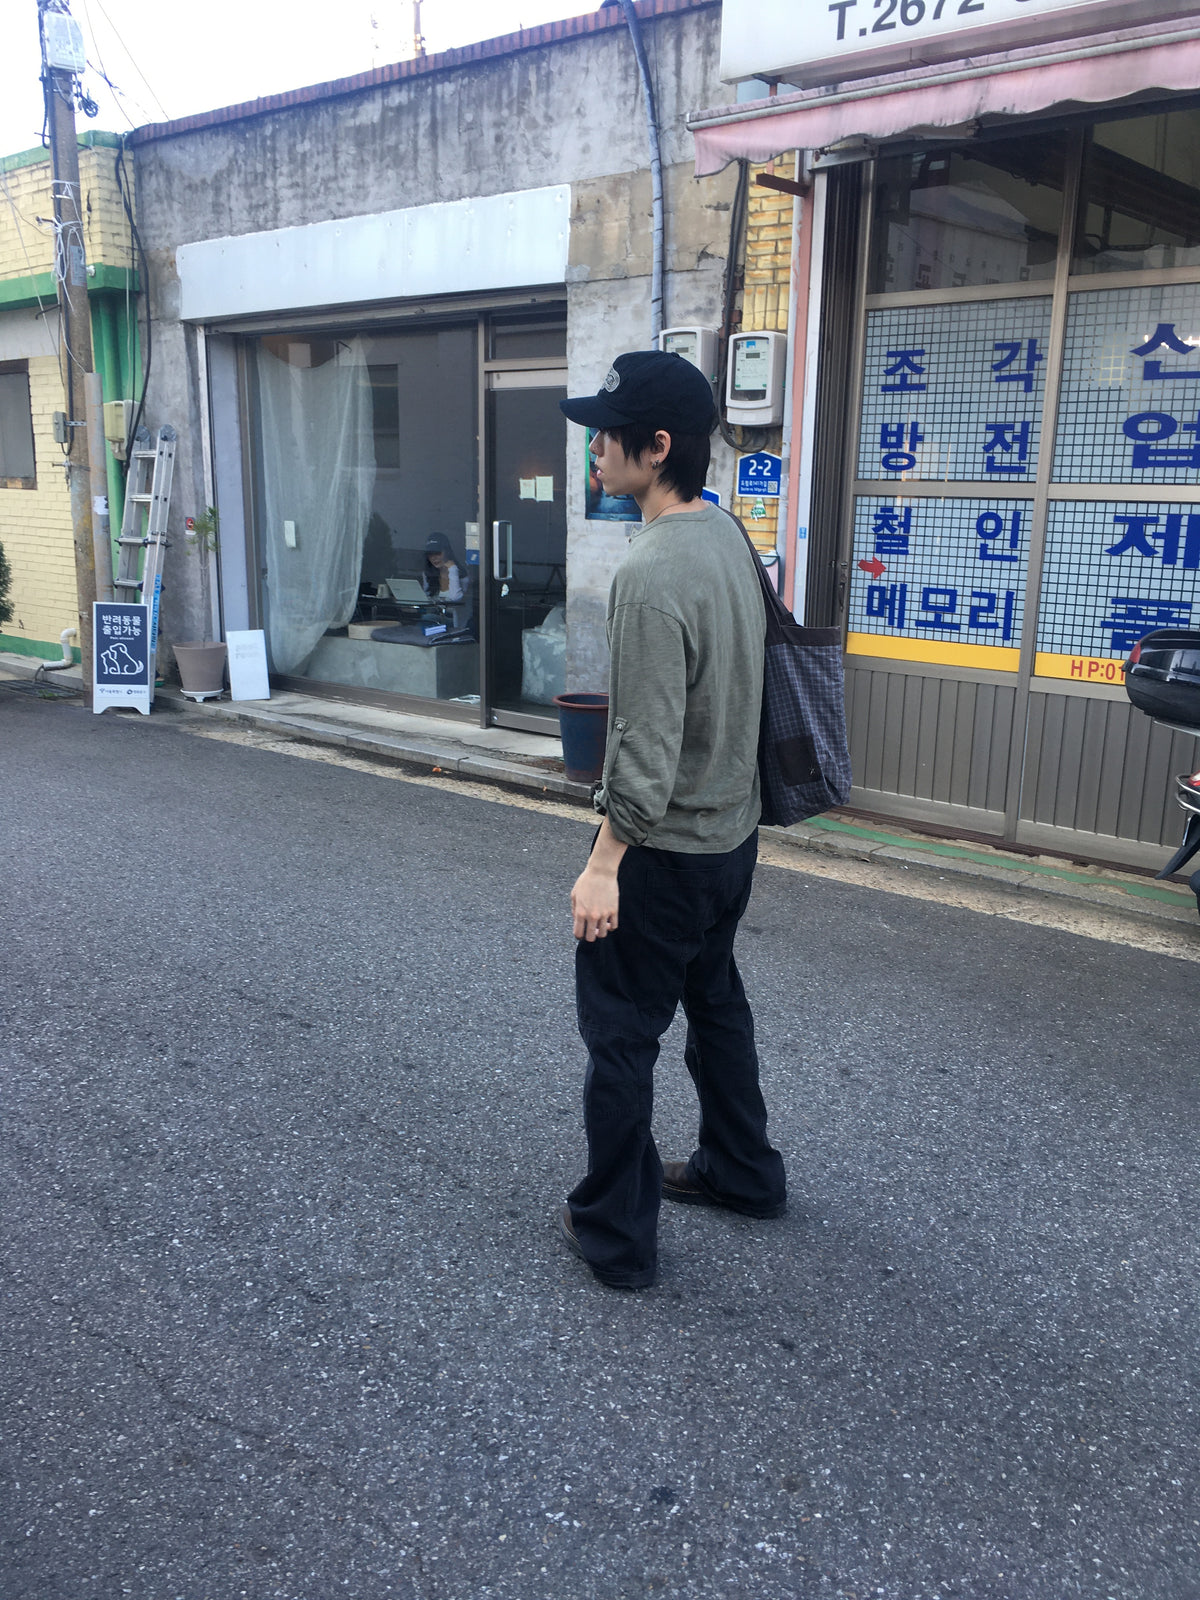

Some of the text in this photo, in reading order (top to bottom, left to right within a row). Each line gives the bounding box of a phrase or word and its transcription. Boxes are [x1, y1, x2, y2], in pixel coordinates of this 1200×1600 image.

[748, 459, 772, 476] 2-2
[866, 583, 1016, 641] 메모리
[102, 615, 142, 626] 반려동물
[102, 625, 142, 637] 출입가능
